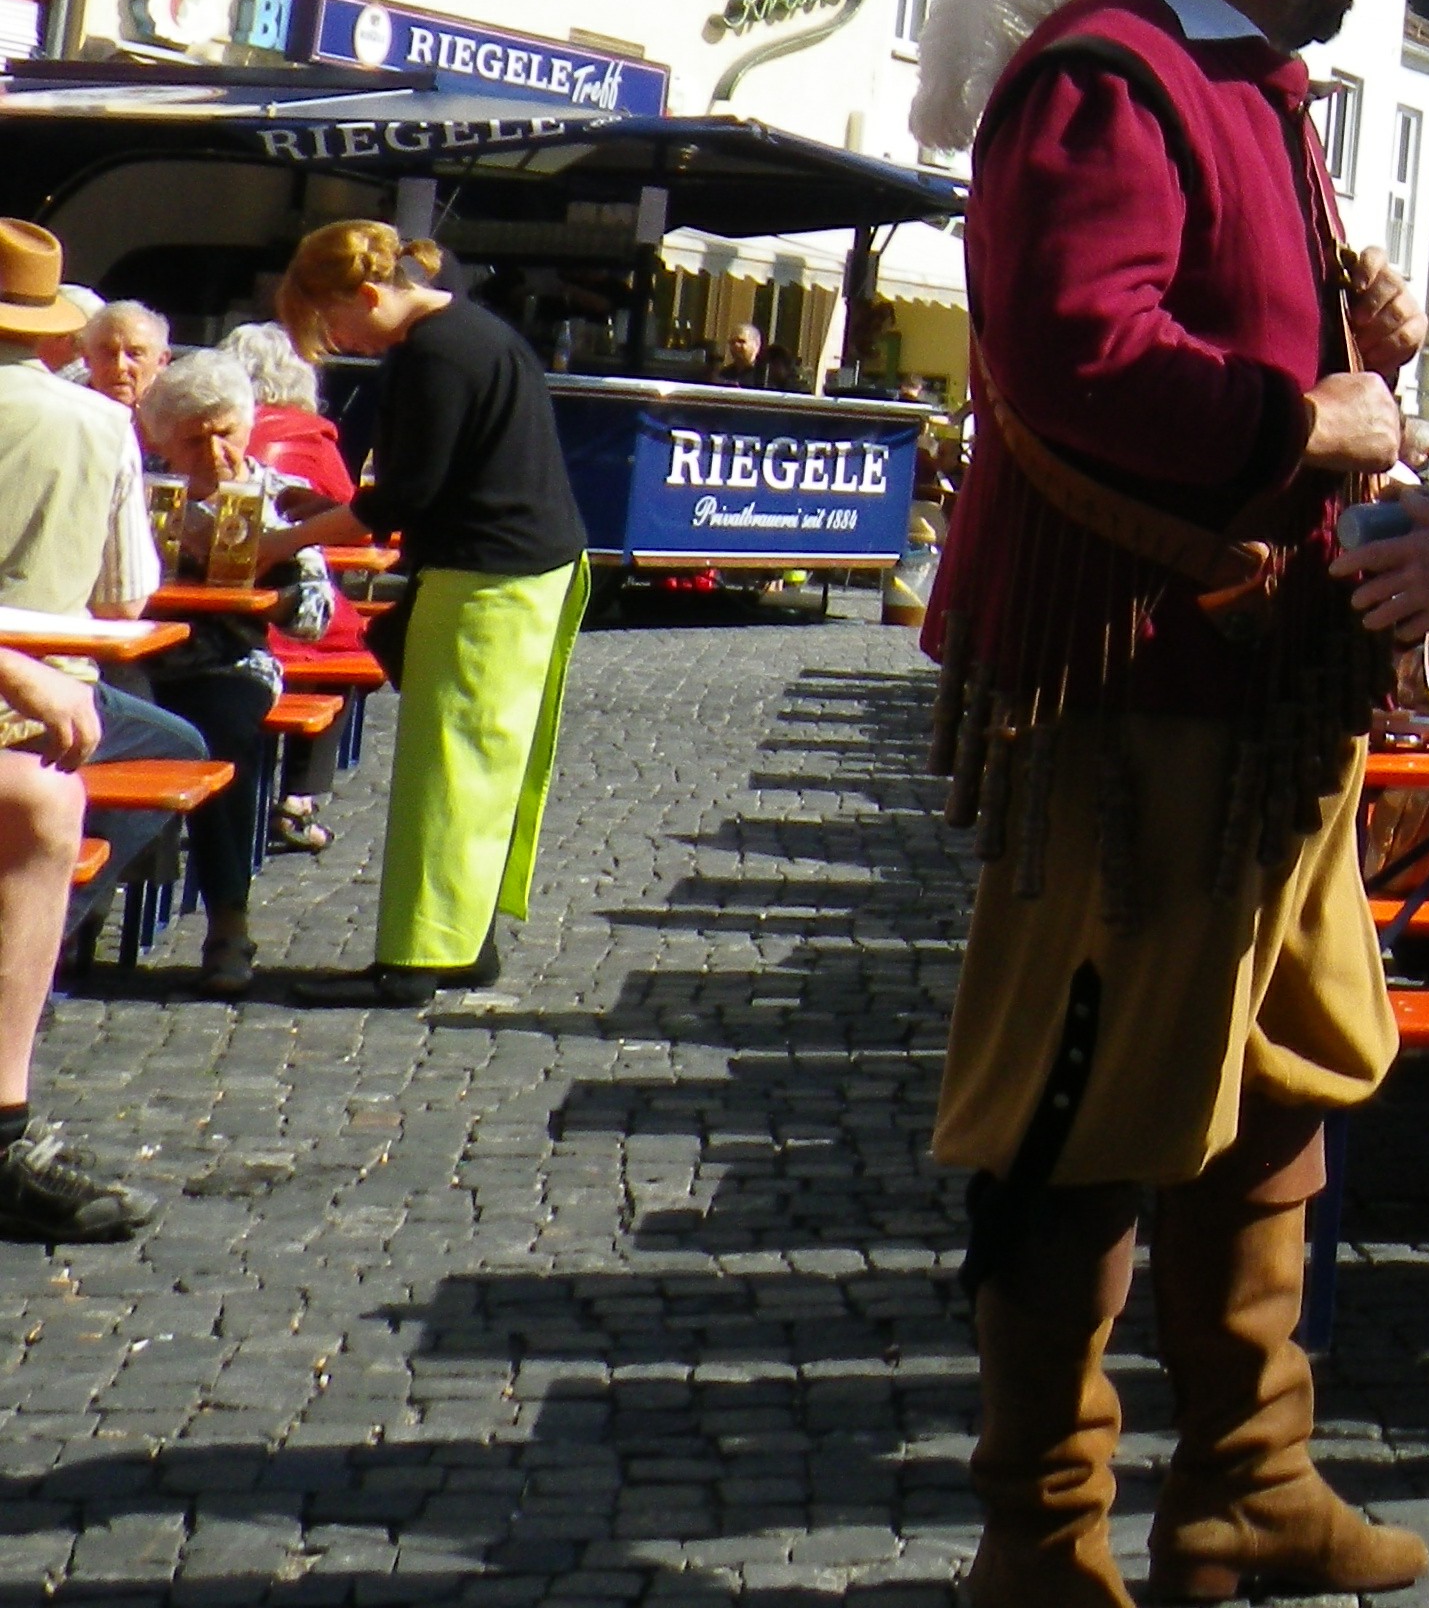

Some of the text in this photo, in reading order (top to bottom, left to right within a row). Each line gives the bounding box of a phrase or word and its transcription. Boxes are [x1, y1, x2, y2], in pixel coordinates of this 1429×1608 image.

[406, 26, 626, 112] RIEGELE Treff
[256, 117, 564, 160] RIEGELE
[665, 429, 889, 494] RIEGELE
[692, 495, 801, 529] Privatbrauerei
[801, 509, 826, 529] seit
